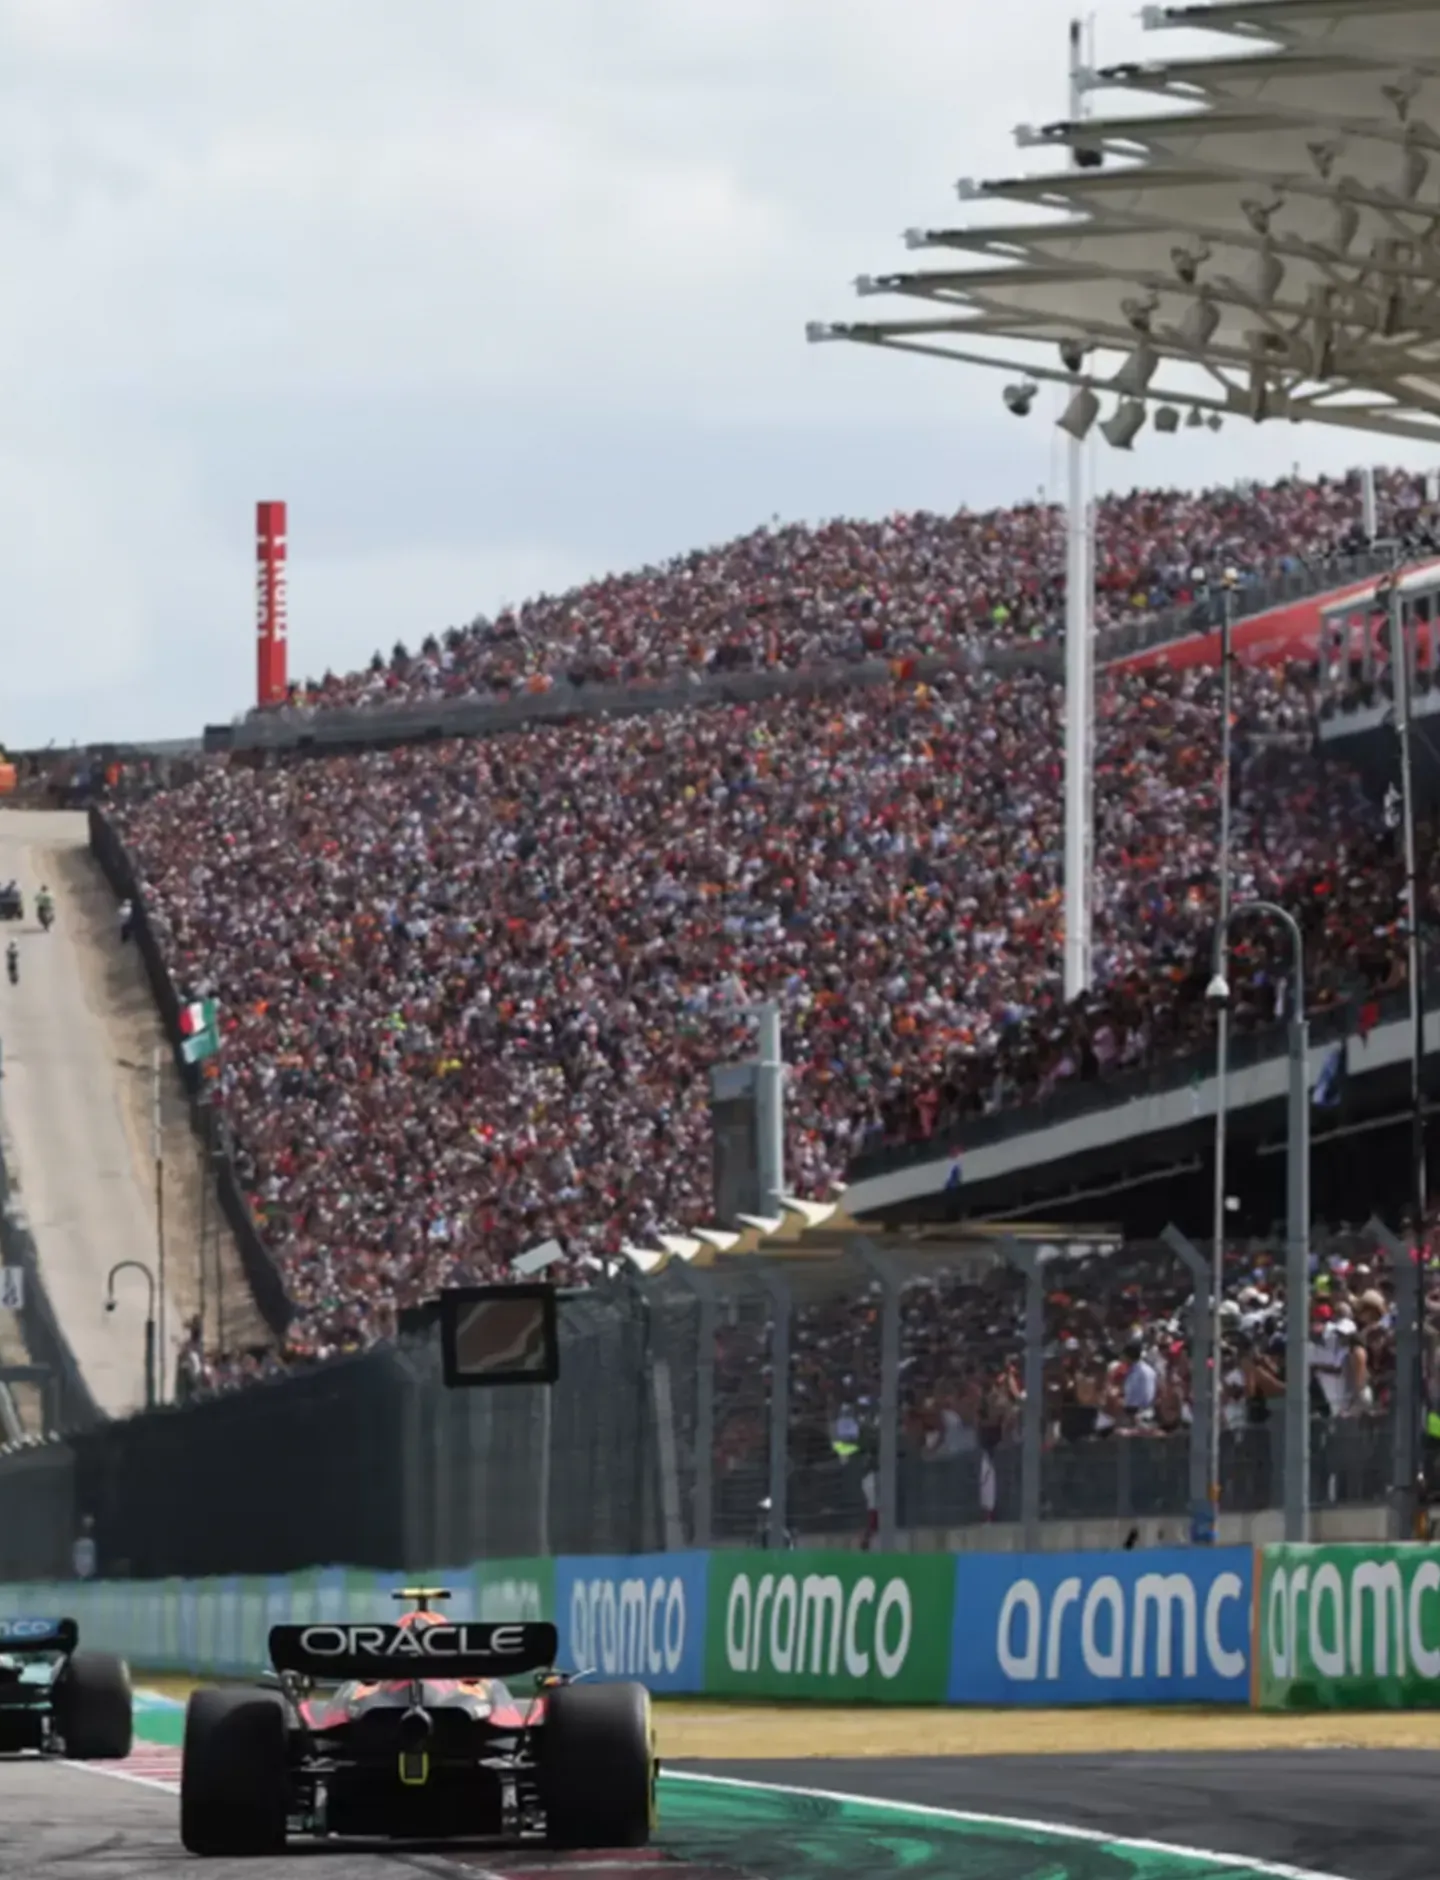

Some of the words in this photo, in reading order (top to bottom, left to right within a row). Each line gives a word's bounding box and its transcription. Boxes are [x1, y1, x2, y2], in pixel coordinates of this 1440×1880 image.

[300, 1625, 526, 1657] ORACLE
[570, 1575, 686, 1675] aramco
[725, 1572, 913, 1680] aramco
[996, 1571, 1253, 1681] aramc
